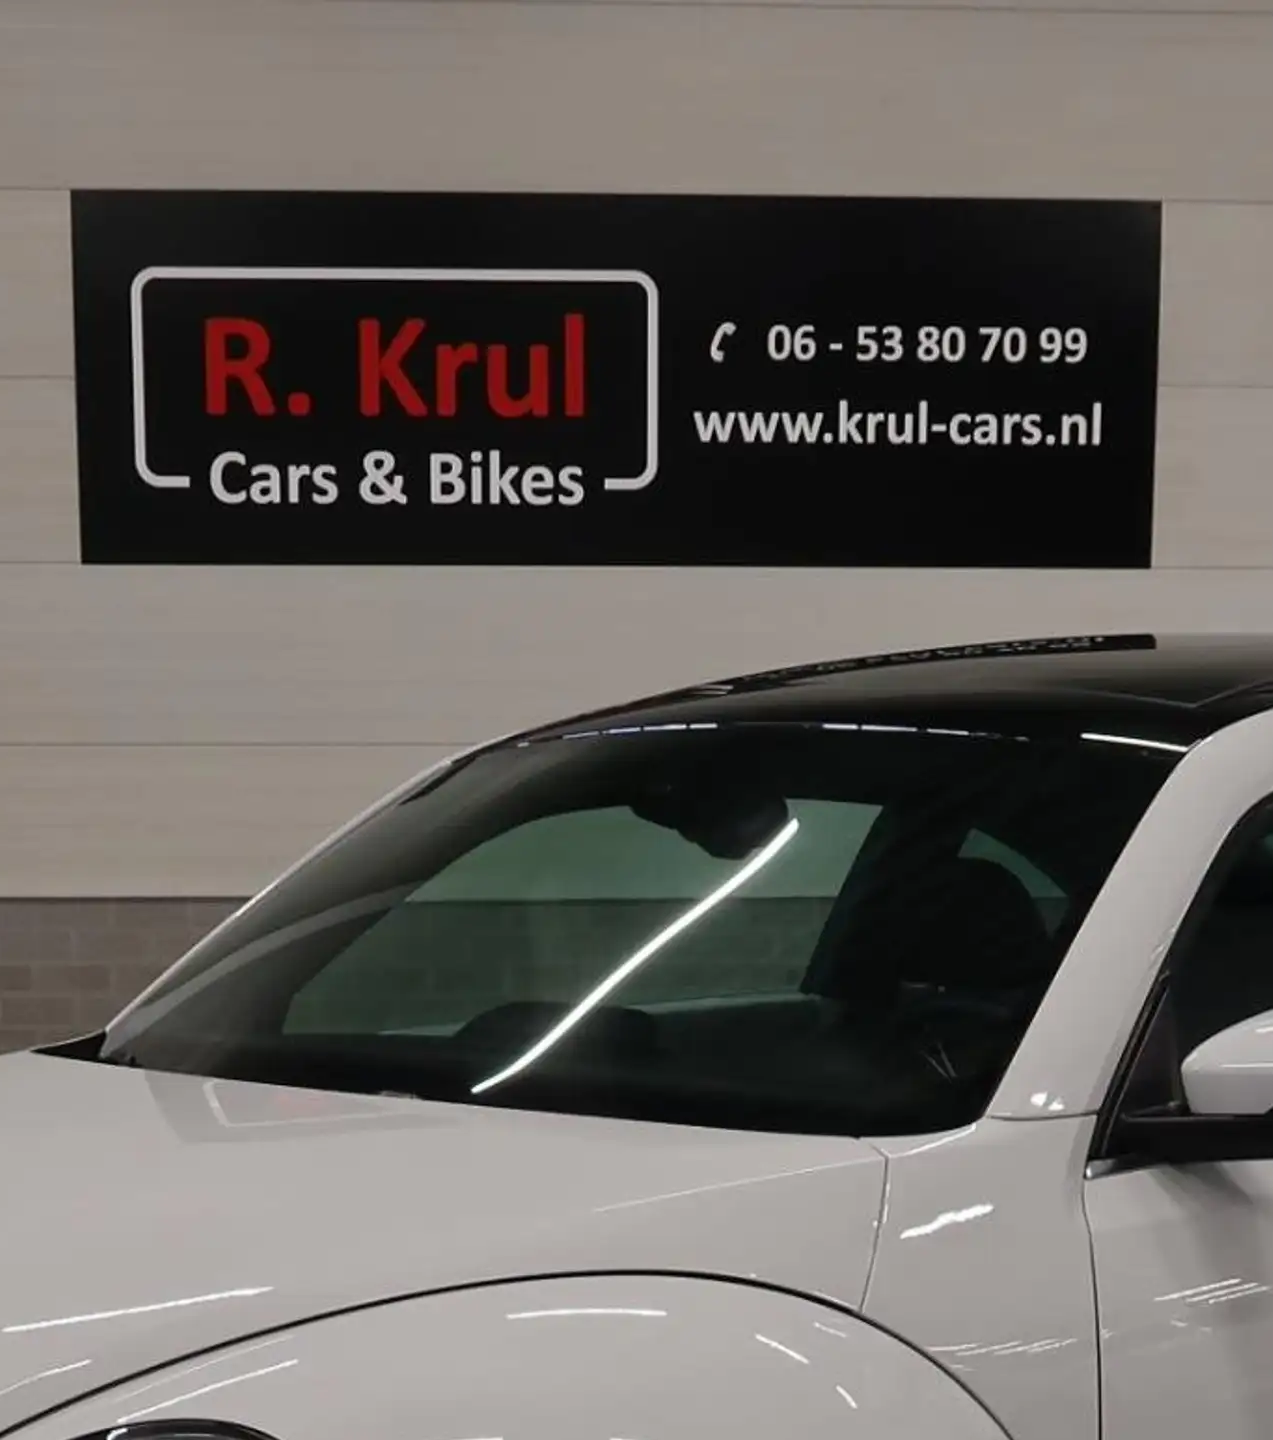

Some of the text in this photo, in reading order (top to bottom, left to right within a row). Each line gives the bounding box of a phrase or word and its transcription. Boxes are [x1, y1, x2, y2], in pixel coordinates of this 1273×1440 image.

[204, 313, 587, 420] R. Krul
[766, 323, 817, 362] 06
[855, 324, 905, 363] 53
[916, 325, 967, 363] 80
[978, 326, 1028, 364] 70
[1038, 326, 1088, 364] 99
[692, 398, 1104, 447] www.krul-cars.nl
[208, 448, 586, 507] Cars & Bikes
